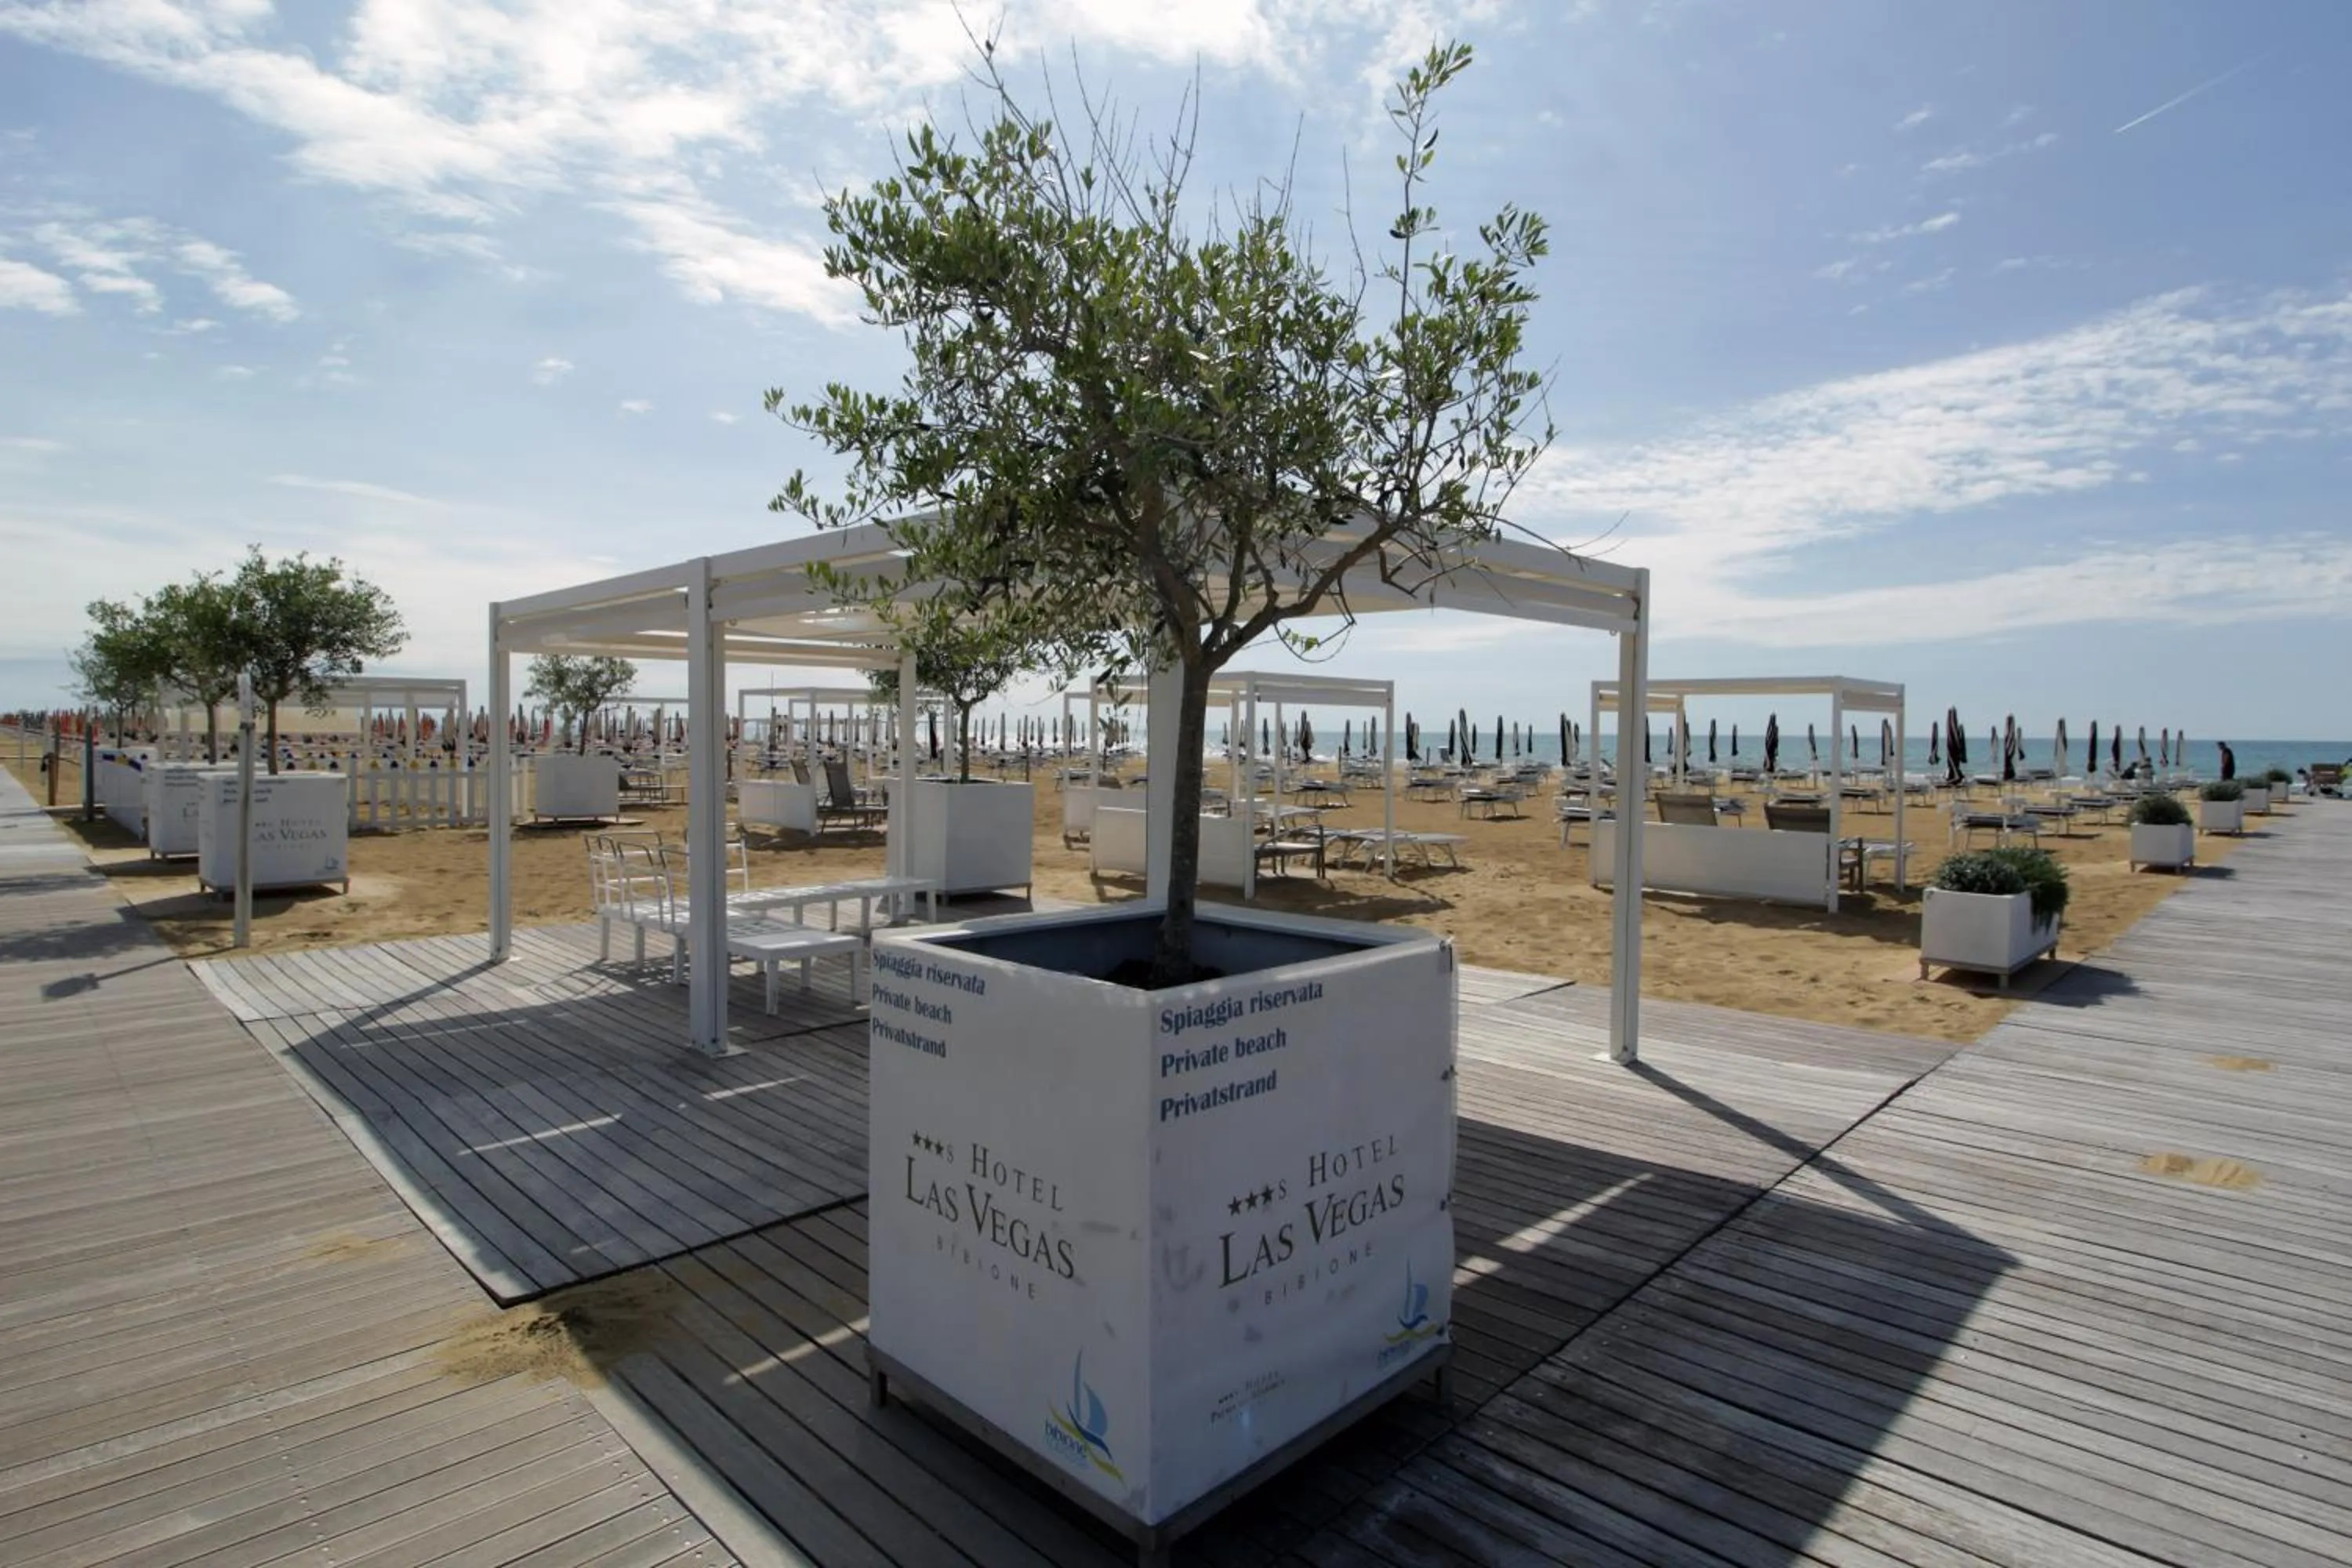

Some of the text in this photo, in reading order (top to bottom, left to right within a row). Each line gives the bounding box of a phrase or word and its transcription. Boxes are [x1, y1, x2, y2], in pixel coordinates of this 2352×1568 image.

[279, 828, 327, 841] VEGAS
[873, 947, 986, 996] Spiaggia riservata
[872, 983, 952, 1024] Private beach
[1160, 979, 1323, 1035] Spiaggia riservata
[872, 1017, 946, 1058] Privatstrand
[1160, 1027, 1287, 1078] Private beach
[1160, 1069, 1278, 1122] Privatstrand
[971, 1142, 1064, 1213] HOTEL
[1308, 1134, 1399, 1189] HOTEL
[906, 1155, 1075, 1280] LAS VEGAS
[1218, 1174, 1405, 1289] LAS VEGAS
[1264, 1240, 1374, 1305] BIBIONE
